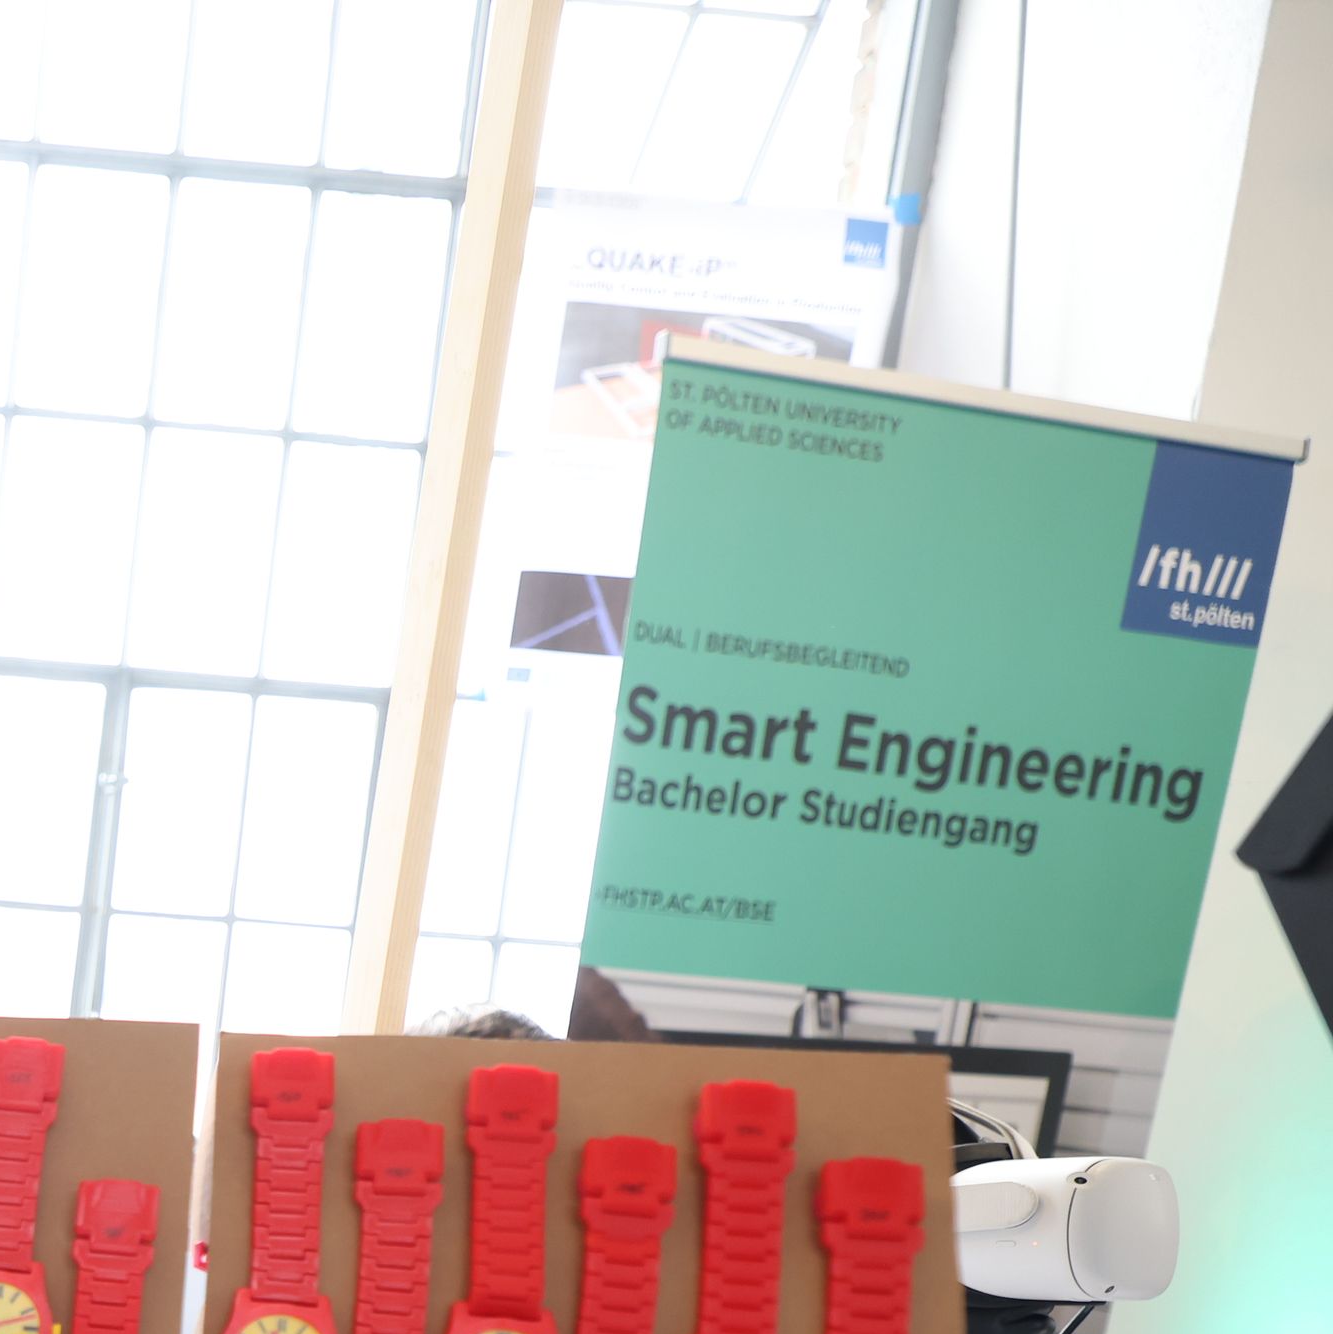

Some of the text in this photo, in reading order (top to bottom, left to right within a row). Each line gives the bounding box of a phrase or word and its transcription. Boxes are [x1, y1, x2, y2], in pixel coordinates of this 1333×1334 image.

[665, 408, 884, 463] OF APPLIED SCIENCES
[785, 400, 902, 435] UNIVERSITY
[635, 620, 686, 649] DUAL
[706, 632, 910, 679] BERUFSBEGLEITEND
[623, 684, 1203, 823] Smart Engineering
[613, 766, 1039, 856] Bachelor Studiengang
